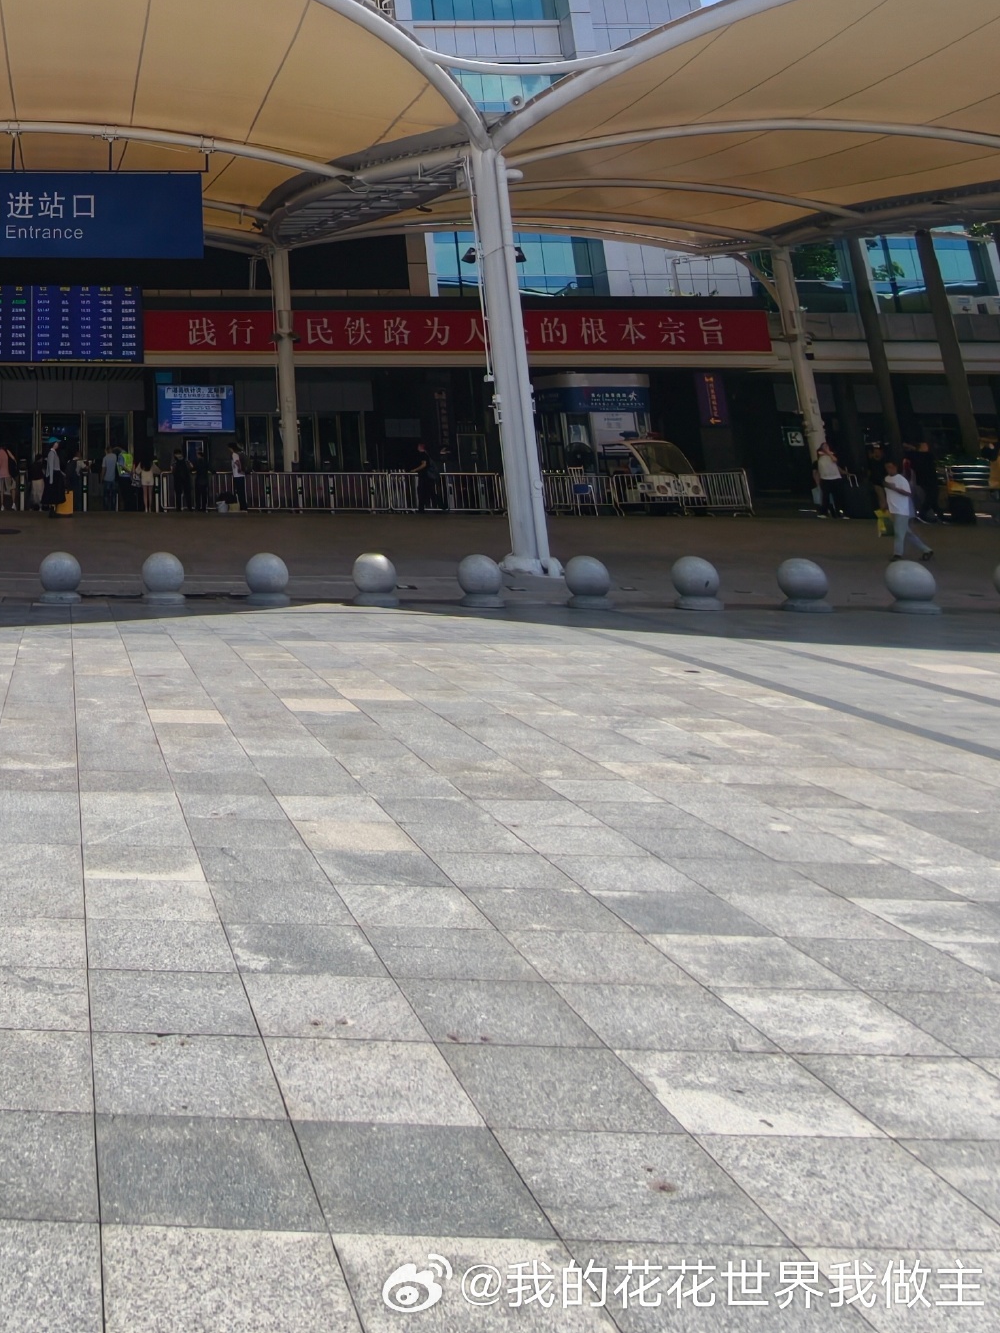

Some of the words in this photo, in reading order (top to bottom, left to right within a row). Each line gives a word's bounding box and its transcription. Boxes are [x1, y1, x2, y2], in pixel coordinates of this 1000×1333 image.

[6, 191, 95, 219] 进站口
[5, 225, 83, 239] Entrance
[187, 316, 724, 347] 践行民铁路为人的根本宗旨
